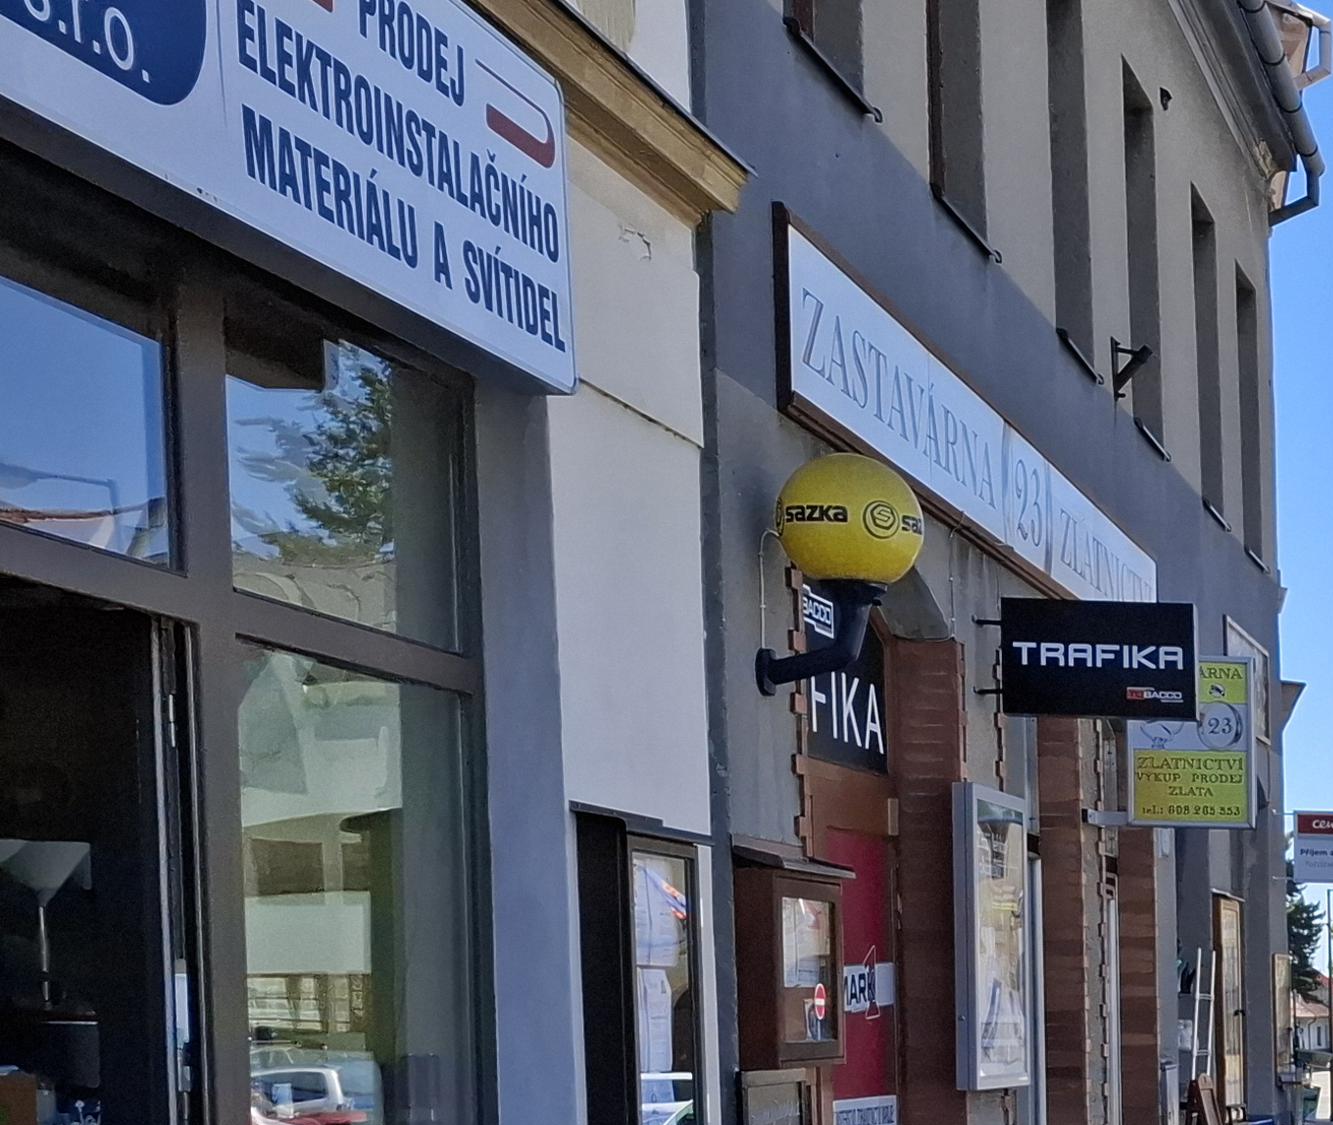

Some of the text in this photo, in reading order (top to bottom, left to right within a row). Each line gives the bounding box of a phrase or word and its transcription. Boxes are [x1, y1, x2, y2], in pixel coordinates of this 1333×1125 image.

[359, 0, 464, 106] PRODEJ
[237, 0, 560, 264] ELEKTROINSTALAČNÍHO
[241, 104, 566, 352] MATERIÁLU A SVÍTIDEL
[802, 287, 997, 510] ZASTAVÁRNA
[1014, 458, 1043, 547] 23
[1012, 641, 1184, 670] TRAFIKA
[1207, 717, 1232, 735] 23
[1168, 786, 1214, 797] ZLATA
